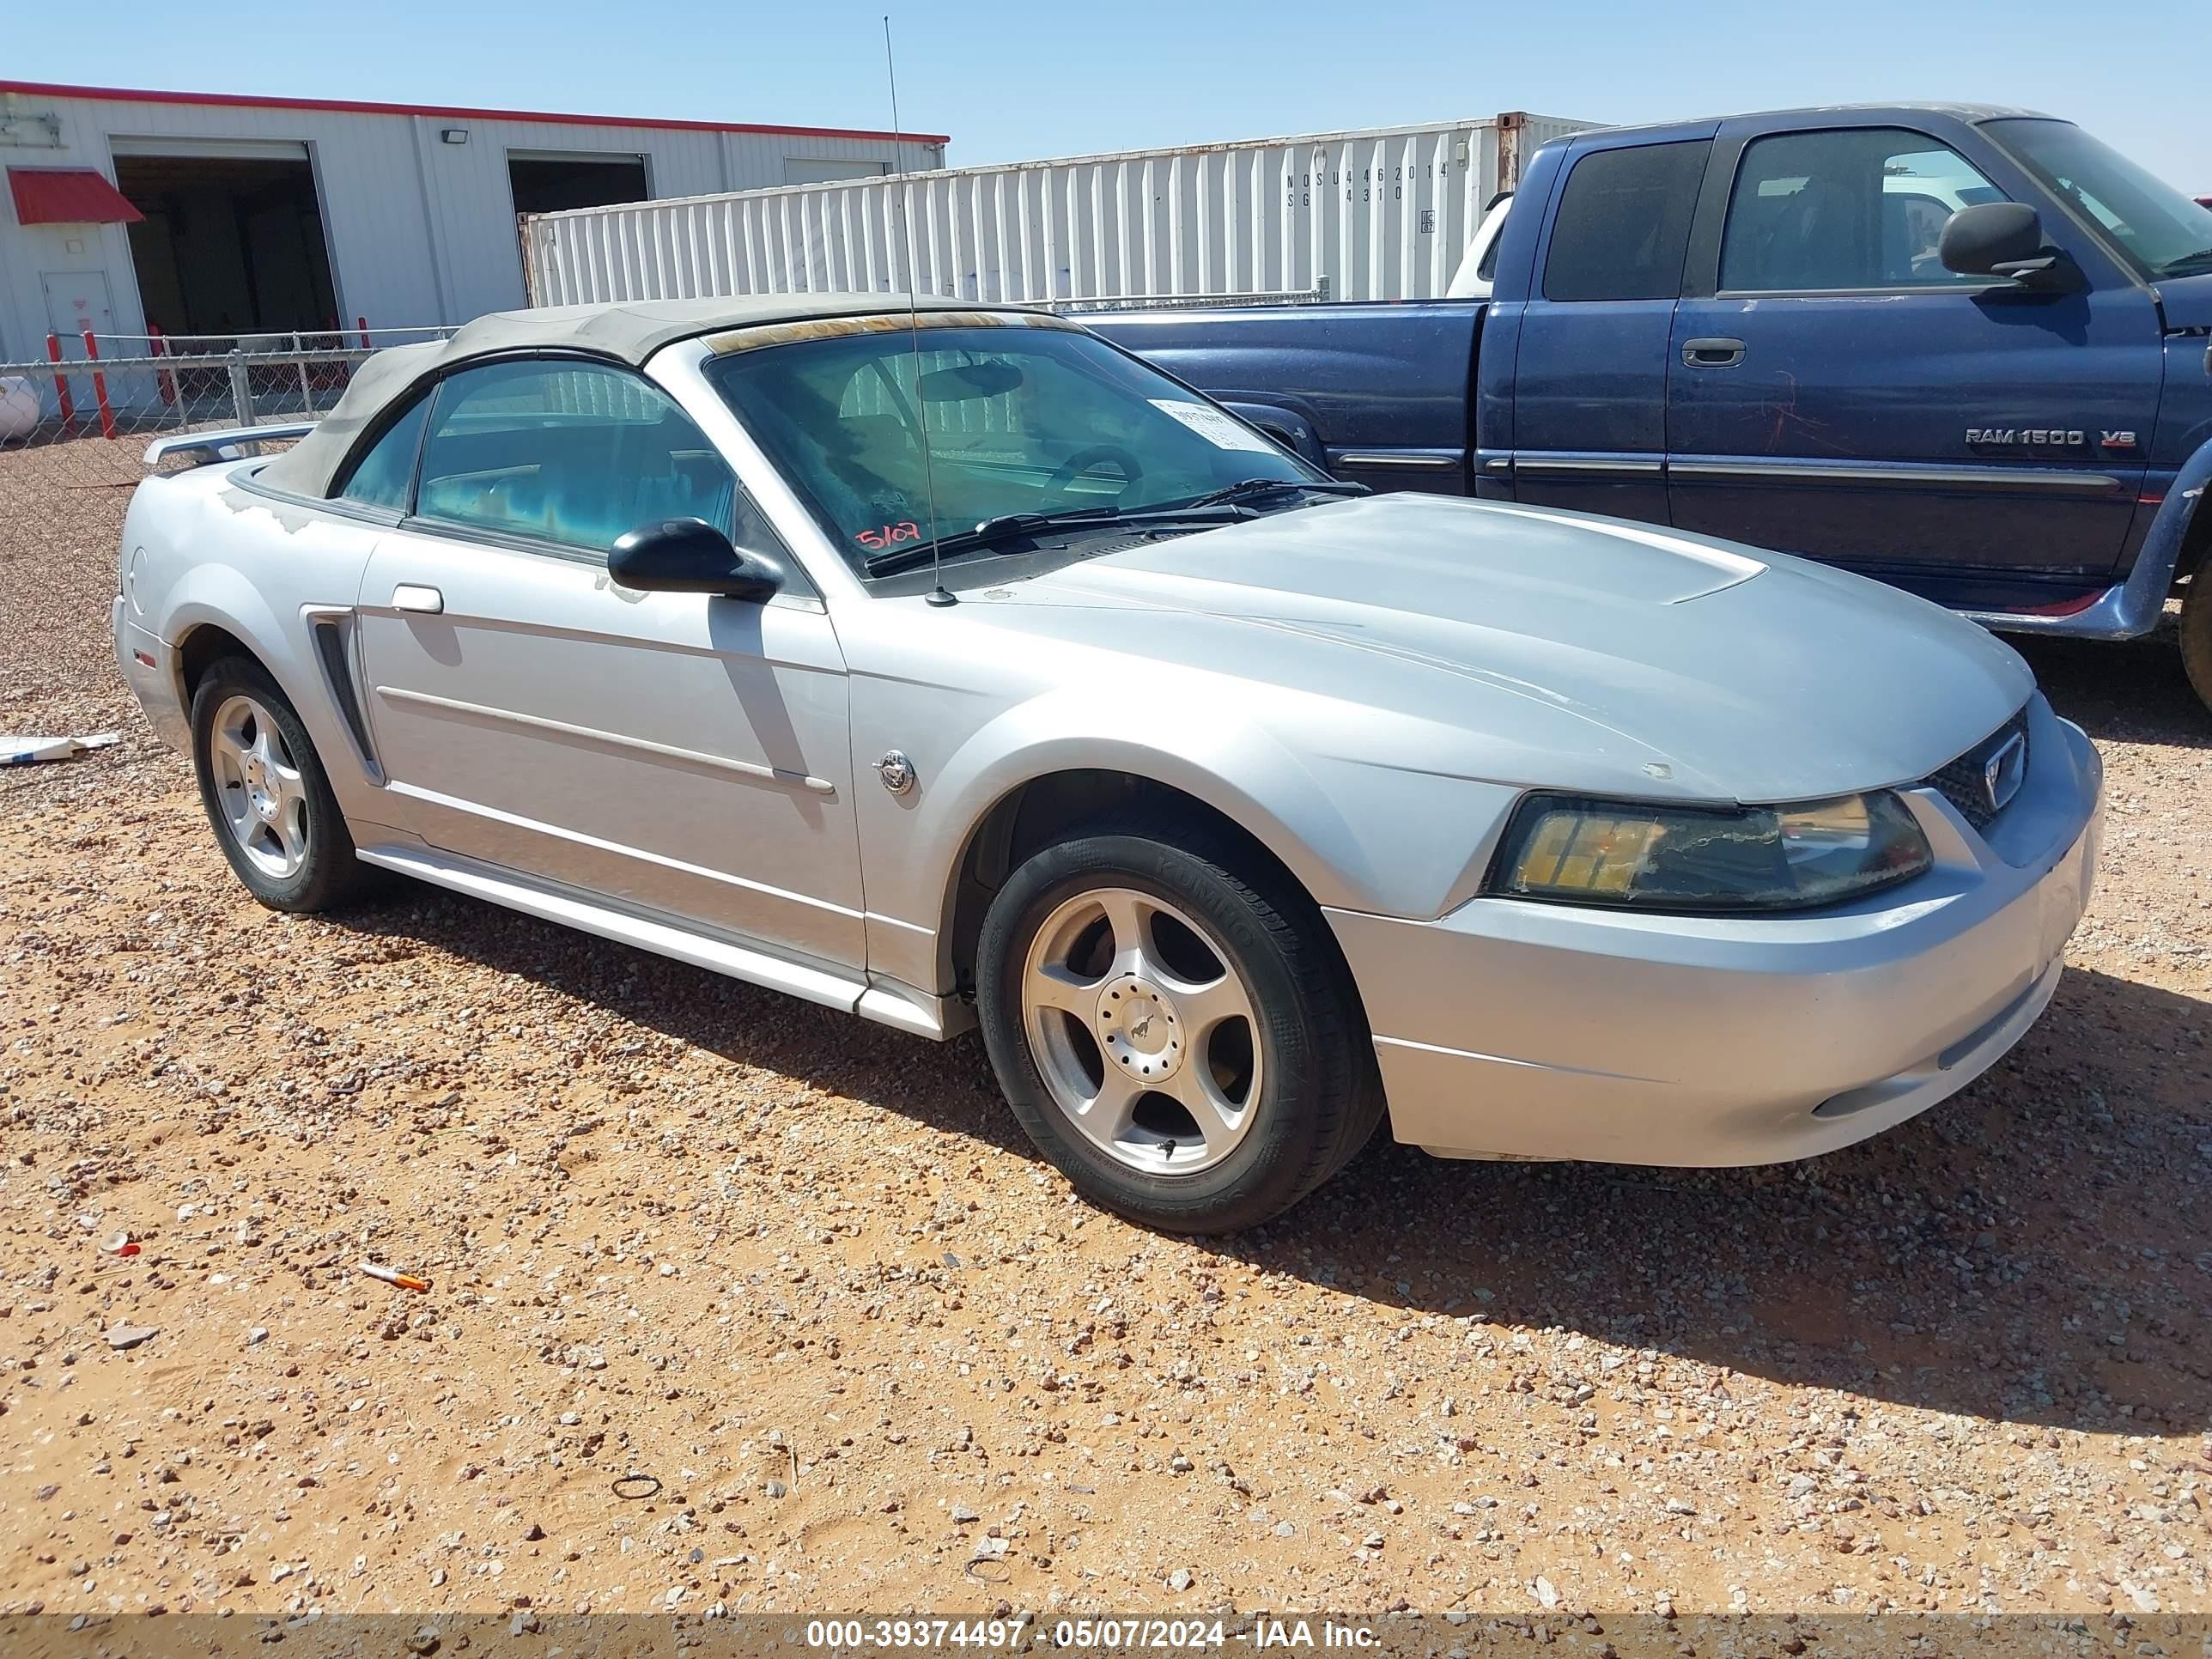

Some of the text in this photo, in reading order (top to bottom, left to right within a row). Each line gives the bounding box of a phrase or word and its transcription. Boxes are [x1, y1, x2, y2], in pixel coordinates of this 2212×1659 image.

[1965, 429, 2136, 445] RAM 1500 V8
